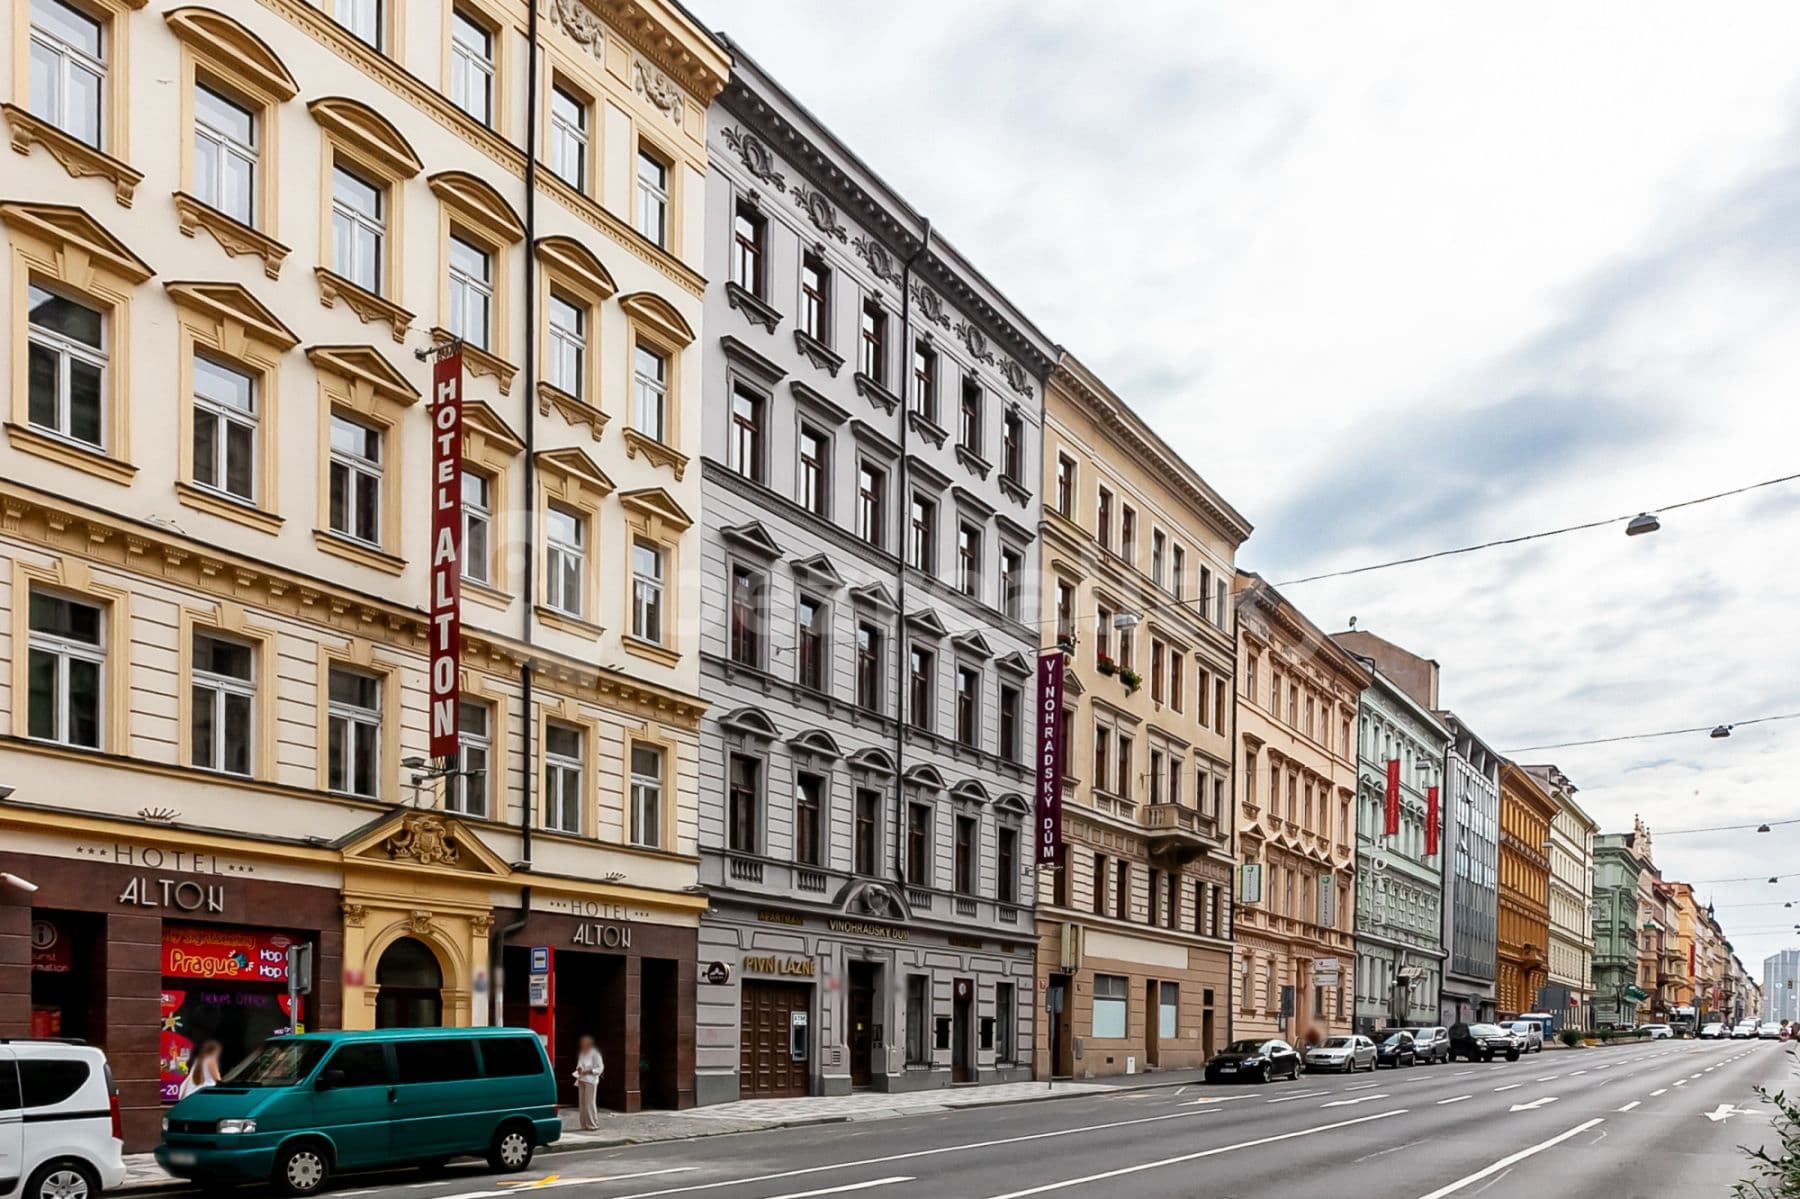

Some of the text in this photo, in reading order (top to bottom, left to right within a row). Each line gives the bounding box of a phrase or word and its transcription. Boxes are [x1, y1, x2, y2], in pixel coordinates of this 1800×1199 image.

[433, 378, 457, 738] HOTEL ALTON
[1043, 660, 1056, 808] VINOHRADSKÝ
[115, 844, 223, 875] HOTEL
[119, 877, 224, 912] ALTON
[571, 900, 631, 921] HOTEL
[573, 923, 631, 948] ALTON
[170, 949, 240, 978] Prague
[259, 948, 283, 963] Hop
[259, 965, 283, 979] Hop
